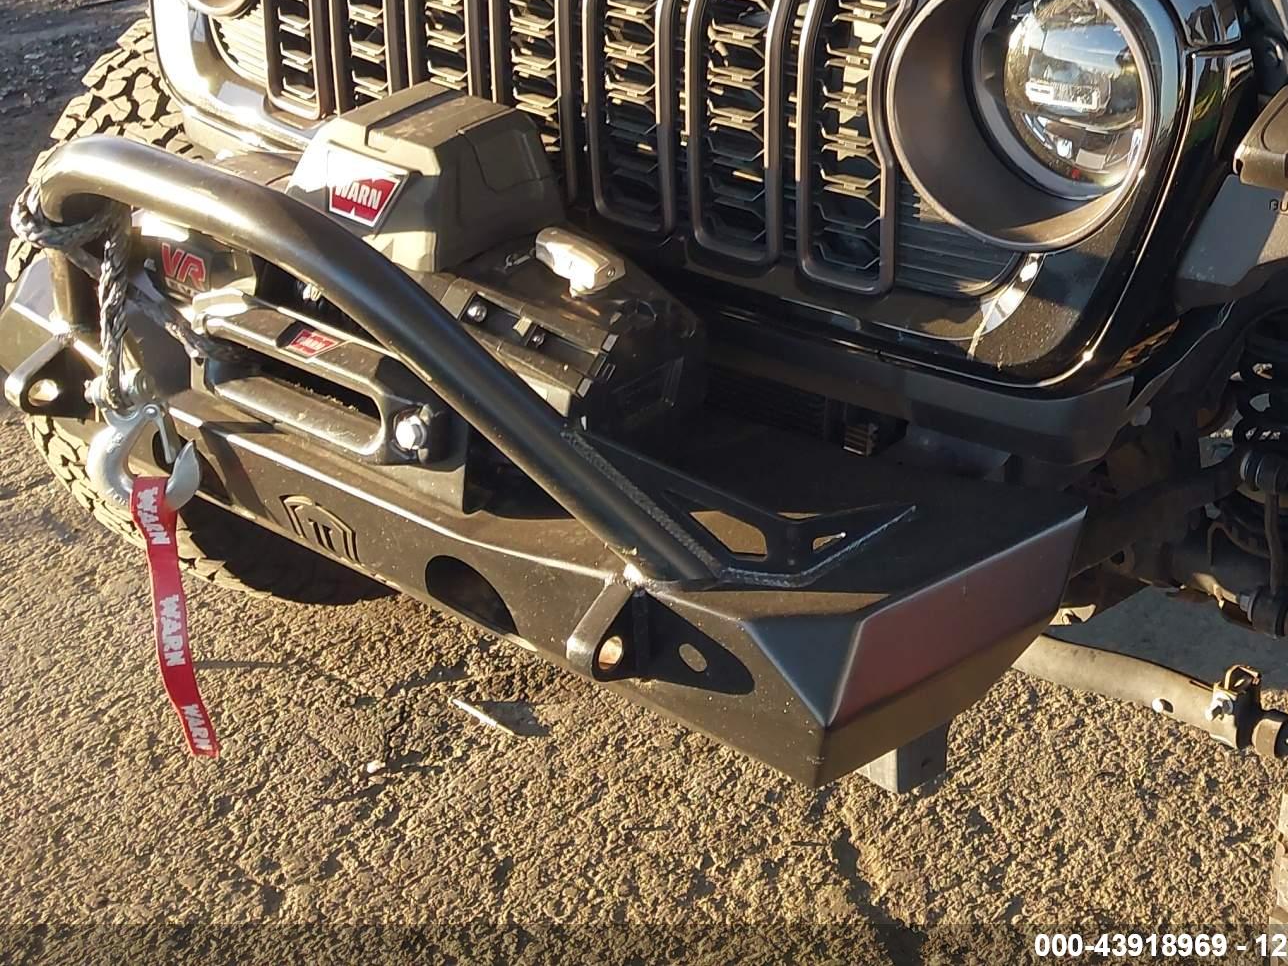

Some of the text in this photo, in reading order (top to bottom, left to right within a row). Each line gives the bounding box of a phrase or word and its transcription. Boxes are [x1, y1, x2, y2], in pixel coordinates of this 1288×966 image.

[334, 181, 382, 210] WARN
[161, 241, 206, 292] VR
[137, 486, 171, 545] WARN
[159, 593, 187, 667] WARN
[181, 704, 213, 751] WARN
